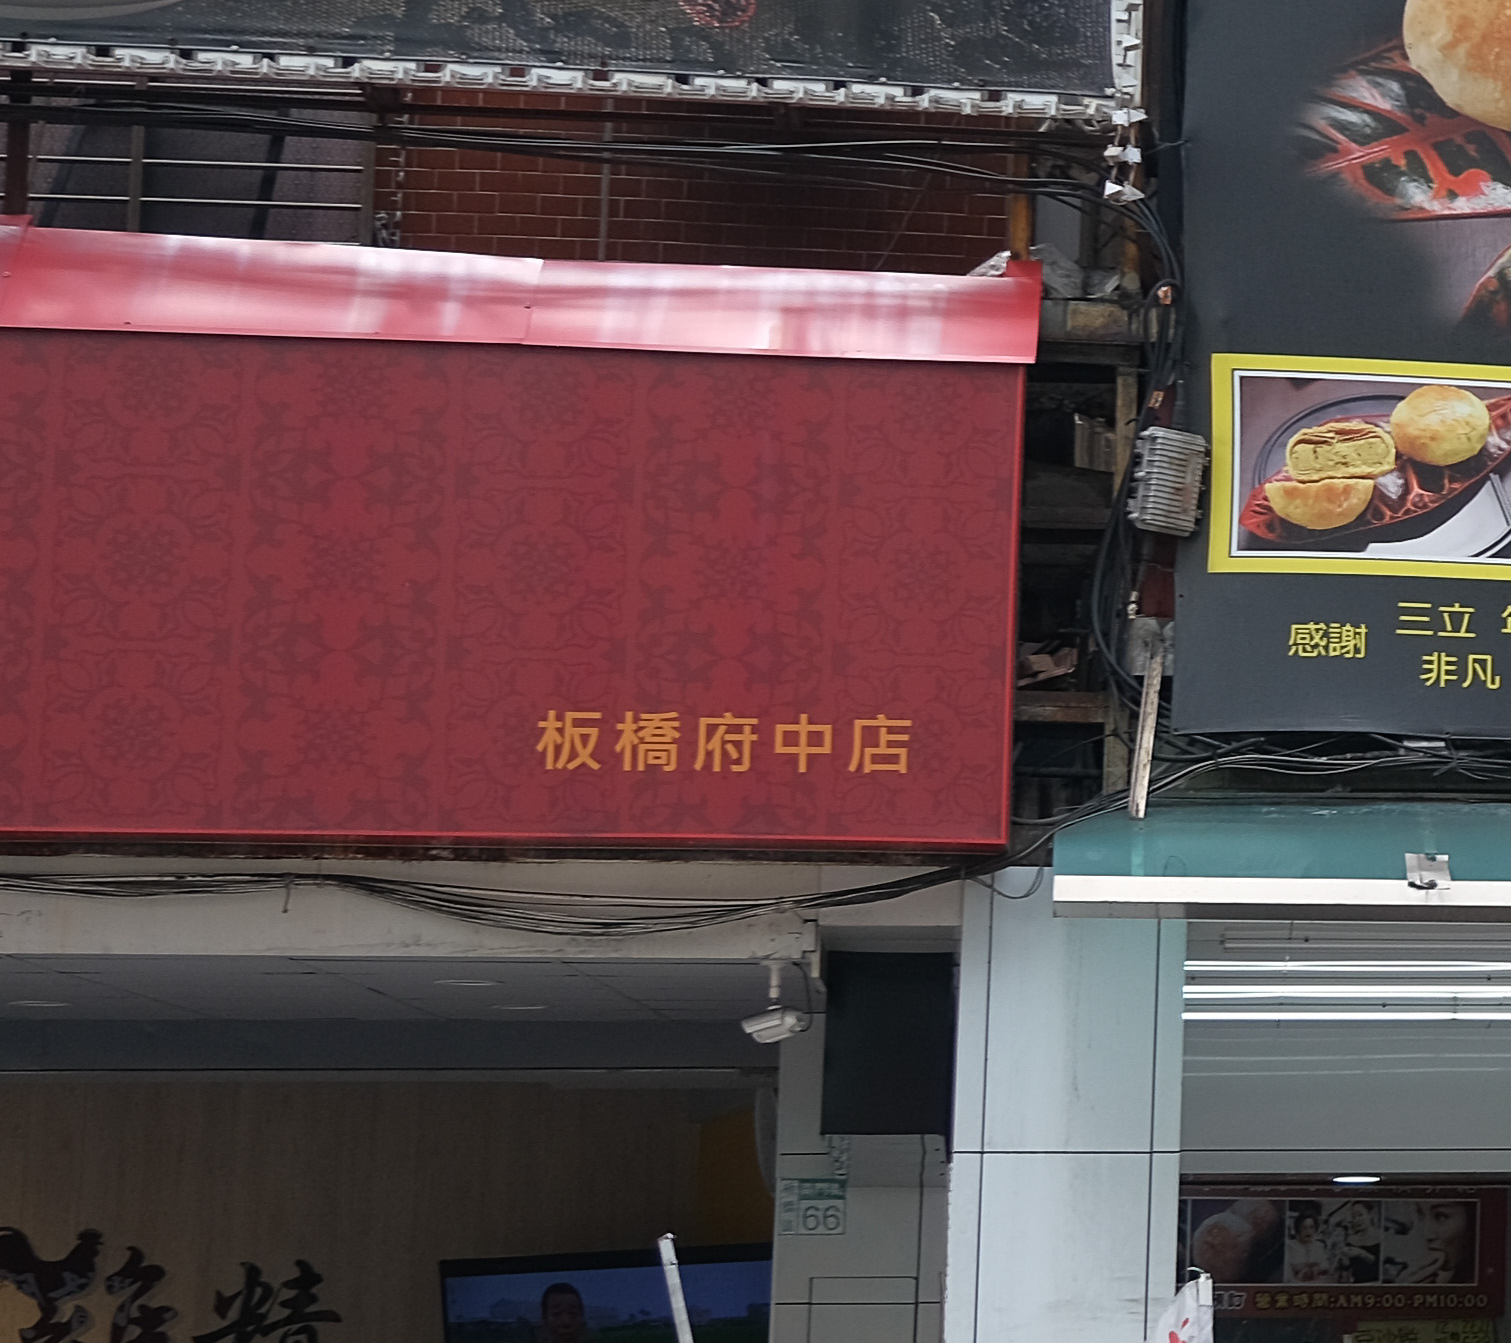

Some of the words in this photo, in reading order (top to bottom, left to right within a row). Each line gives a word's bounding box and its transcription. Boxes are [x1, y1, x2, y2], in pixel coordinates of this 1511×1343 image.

[1287, 622, 1368, 658] 感謝
[1395, 605, 1477, 642] 三立
[1420, 652, 1500, 690] 非凡
[536, 710, 913, 774] 板橋府中店
[803, 1205, 840, 1231] 66
